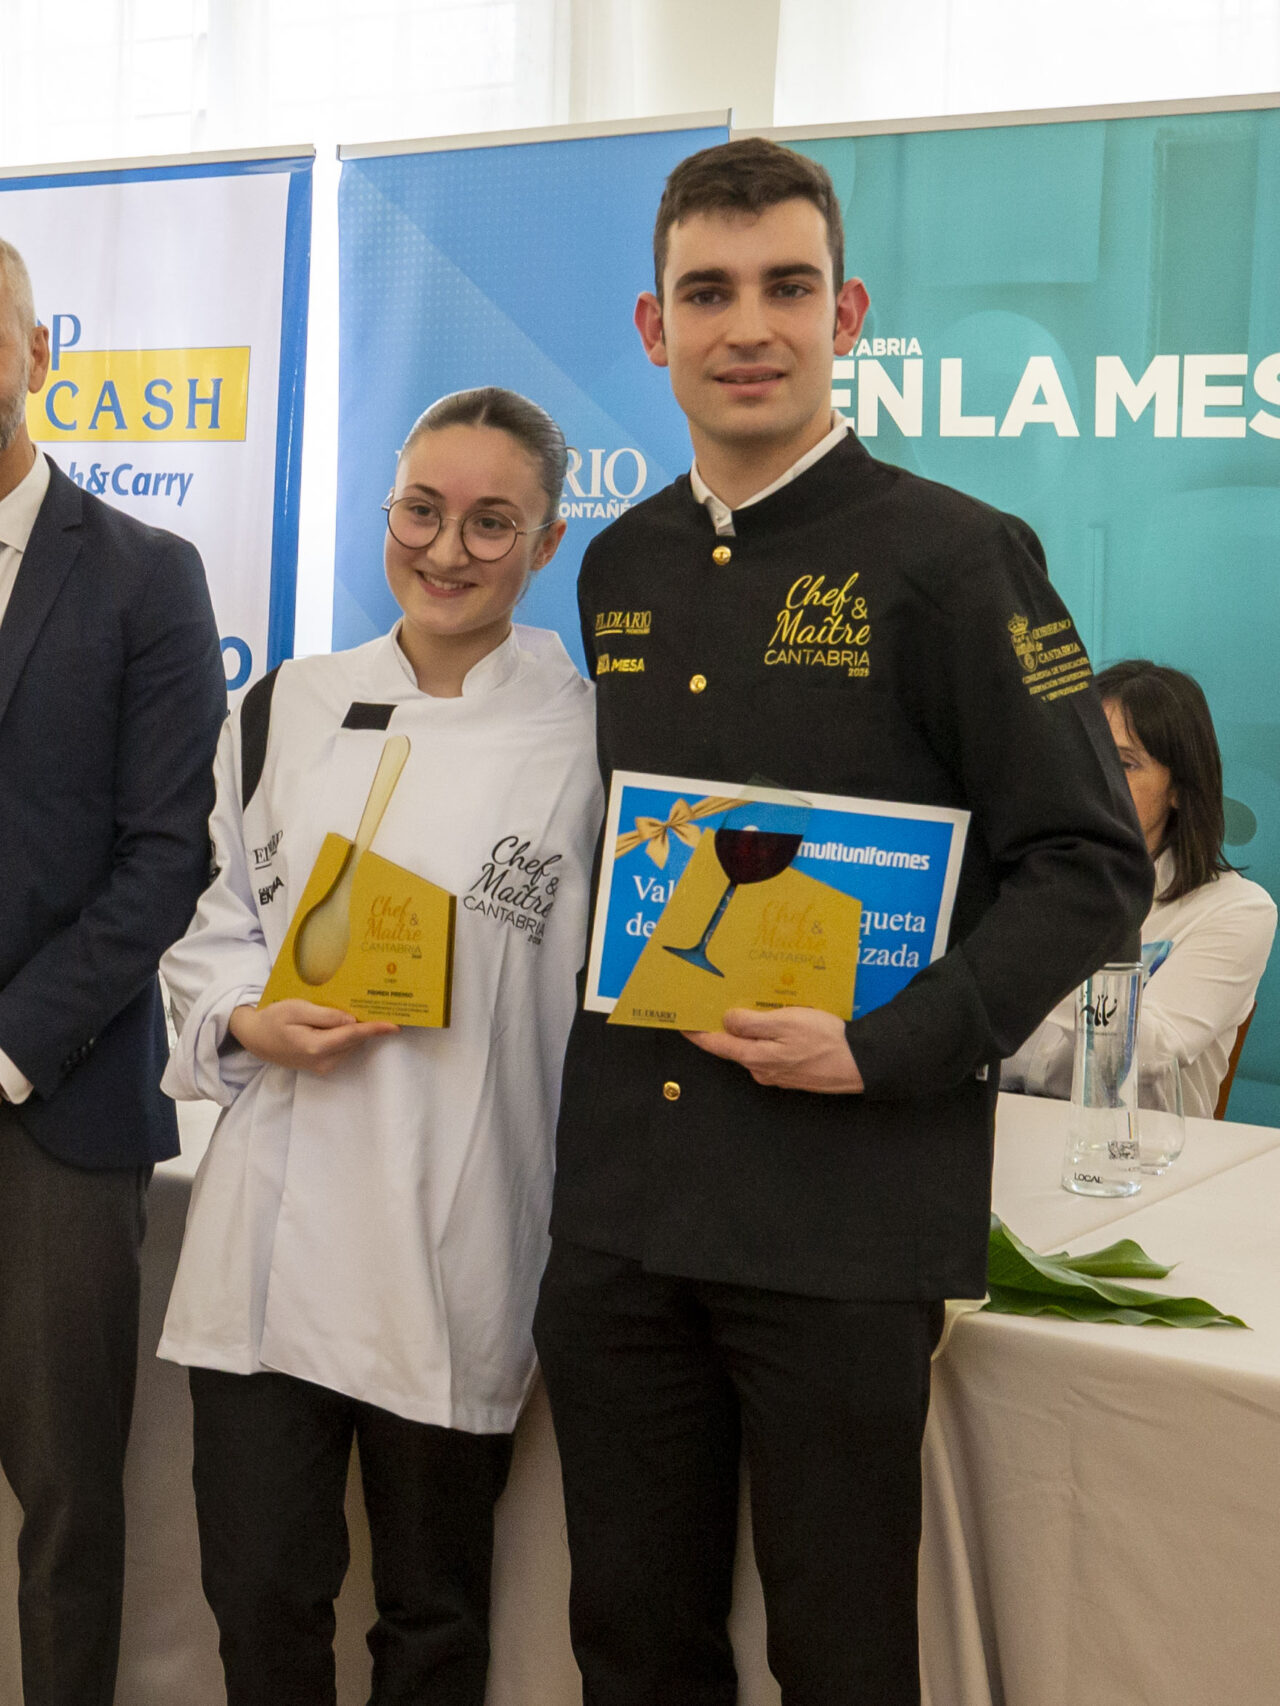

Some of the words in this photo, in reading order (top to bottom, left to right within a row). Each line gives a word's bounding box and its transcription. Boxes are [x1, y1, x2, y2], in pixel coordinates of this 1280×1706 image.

[45, 377, 223, 431] CASH
[939, 355, 1081, 438] LA
[1095, 352, 1280, 439] MES
[69, 461, 194, 507] h&Carry
[561, 447, 648, 499] RIO
[785, 571, 860, 617] Chef
[850, 596, 869, 620] &
[607, 610, 652, 629] DIARIO
[767, 608, 871, 649] Maître
[610, 656, 645, 673] MESA
[764, 648, 870, 668] CANTABRIA
[491, 835, 563, 886] Chef
[545, 876, 560, 897] &
[797, 840, 931, 871] multiuniformes
[632, 874, 676, 903] Val
[371, 895, 412, 924] Chef
[463, 895, 546, 938] CANTABRIA
[860, 909, 926, 936] queta
[857, 939, 920, 969] izada
